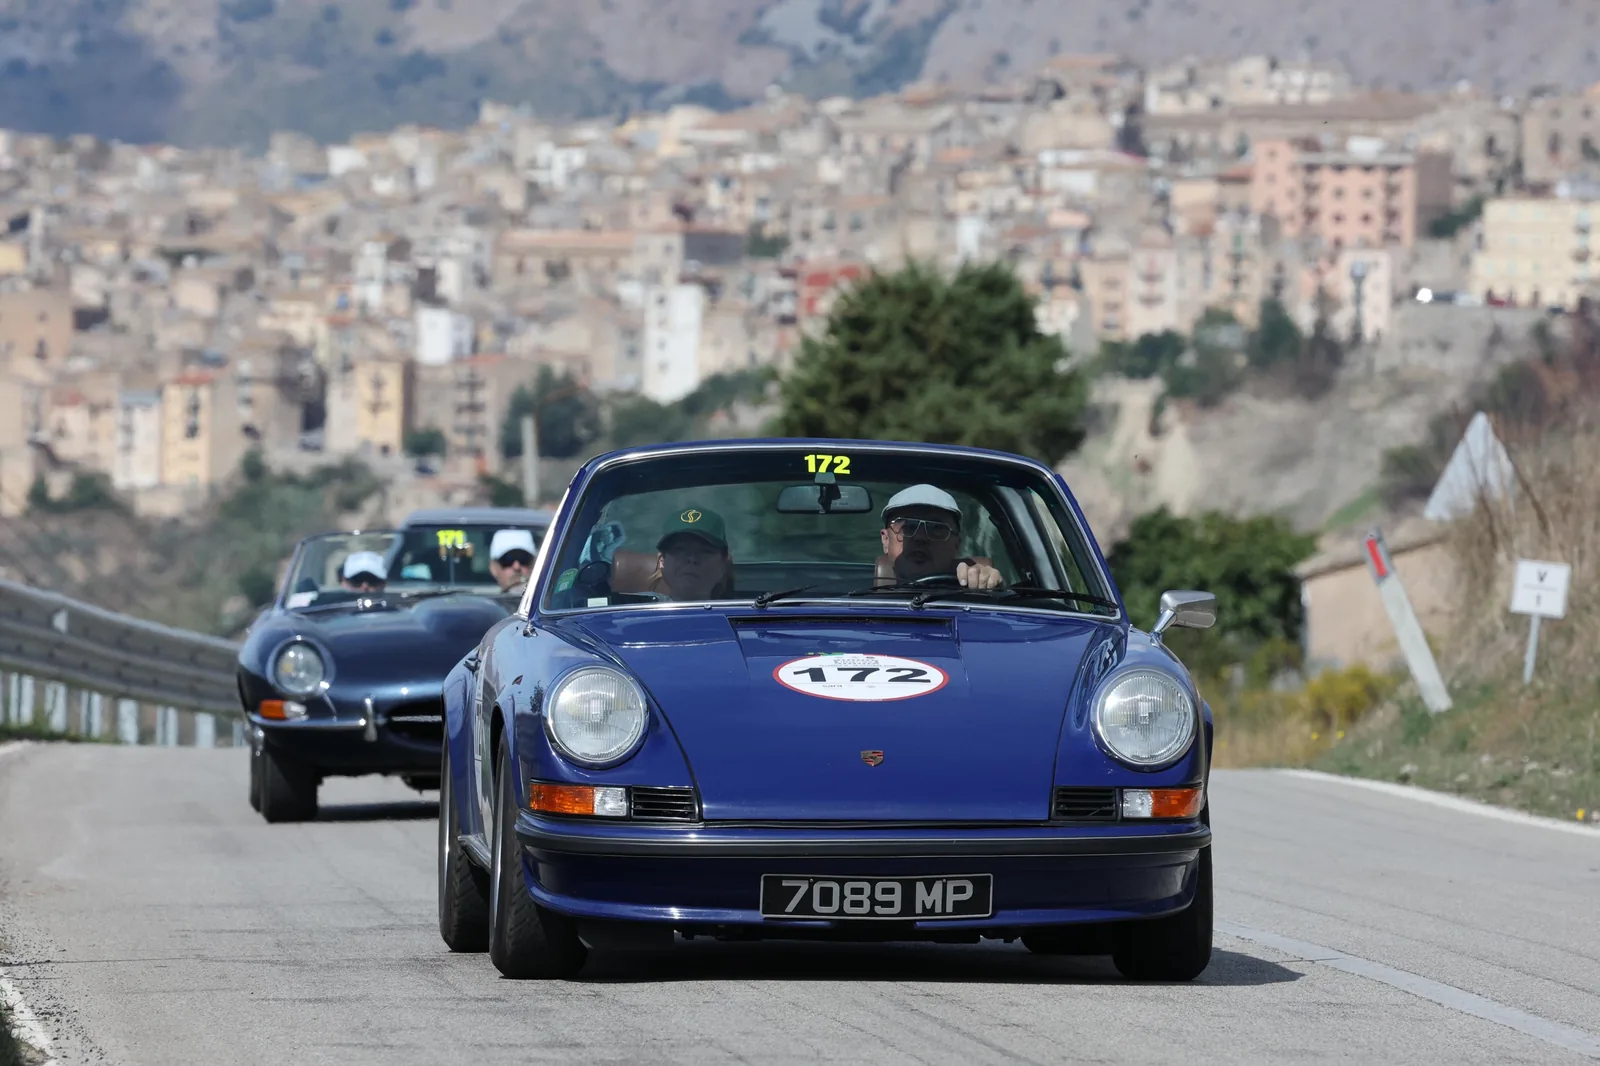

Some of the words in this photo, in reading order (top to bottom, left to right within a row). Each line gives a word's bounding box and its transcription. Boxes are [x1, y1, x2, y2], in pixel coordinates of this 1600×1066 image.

[804, 454, 851, 475] 172
[793, 667, 931, 683] 172
[782, 880, 902, 914] 7089
[915, 879, 974, 914] MP
